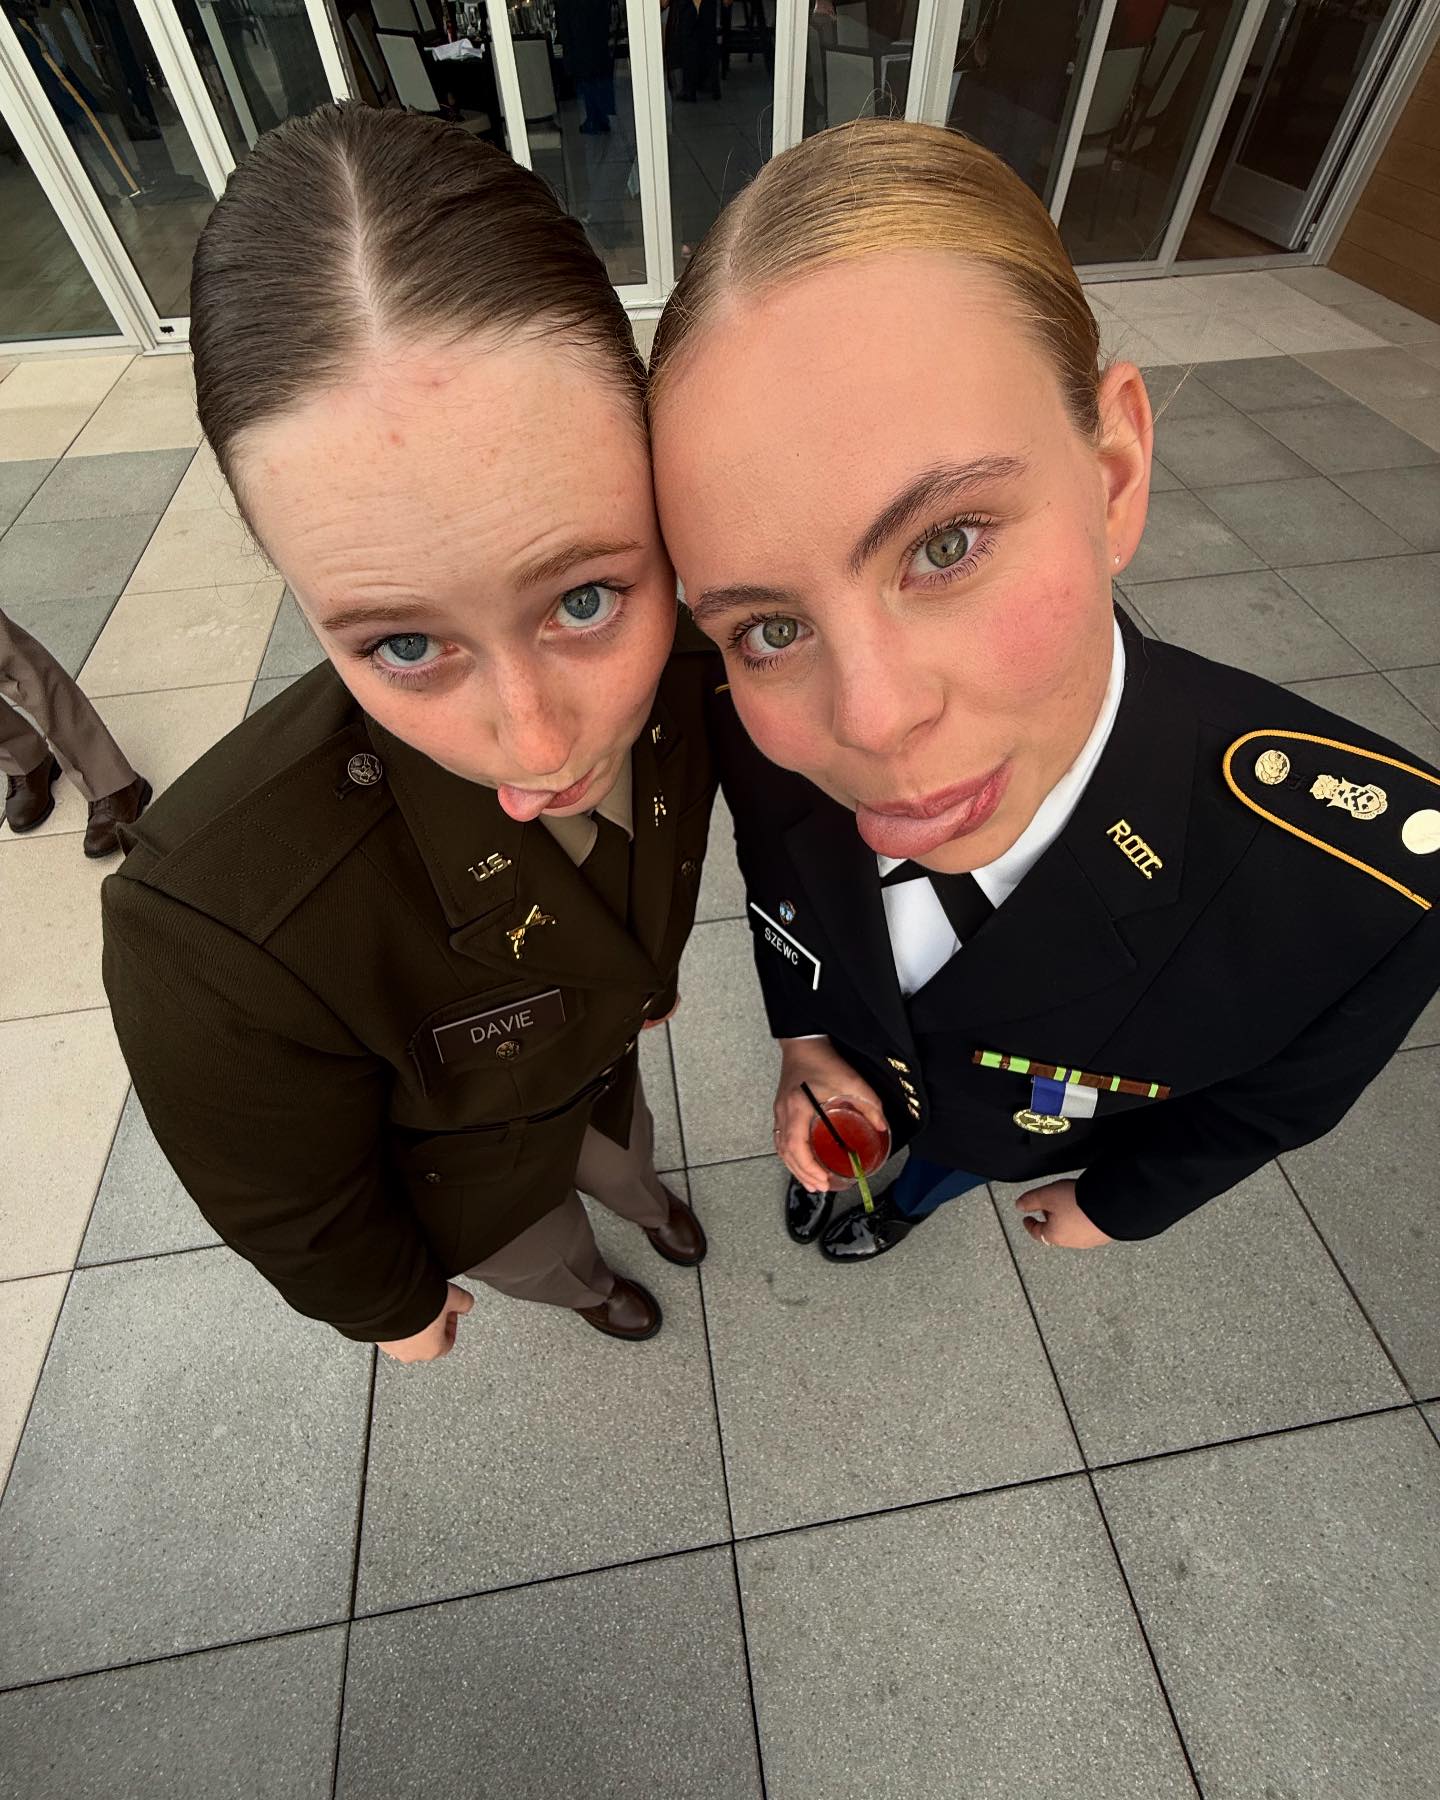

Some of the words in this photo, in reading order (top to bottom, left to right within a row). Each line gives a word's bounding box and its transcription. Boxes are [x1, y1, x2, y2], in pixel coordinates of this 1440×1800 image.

[467, 852, 512, 882] U.S.
[1106, 819, 1163, 880] ROTC
[764, 926, 799, 966] SZEWC
[470, 1009, 534, 1044] DAVIE
